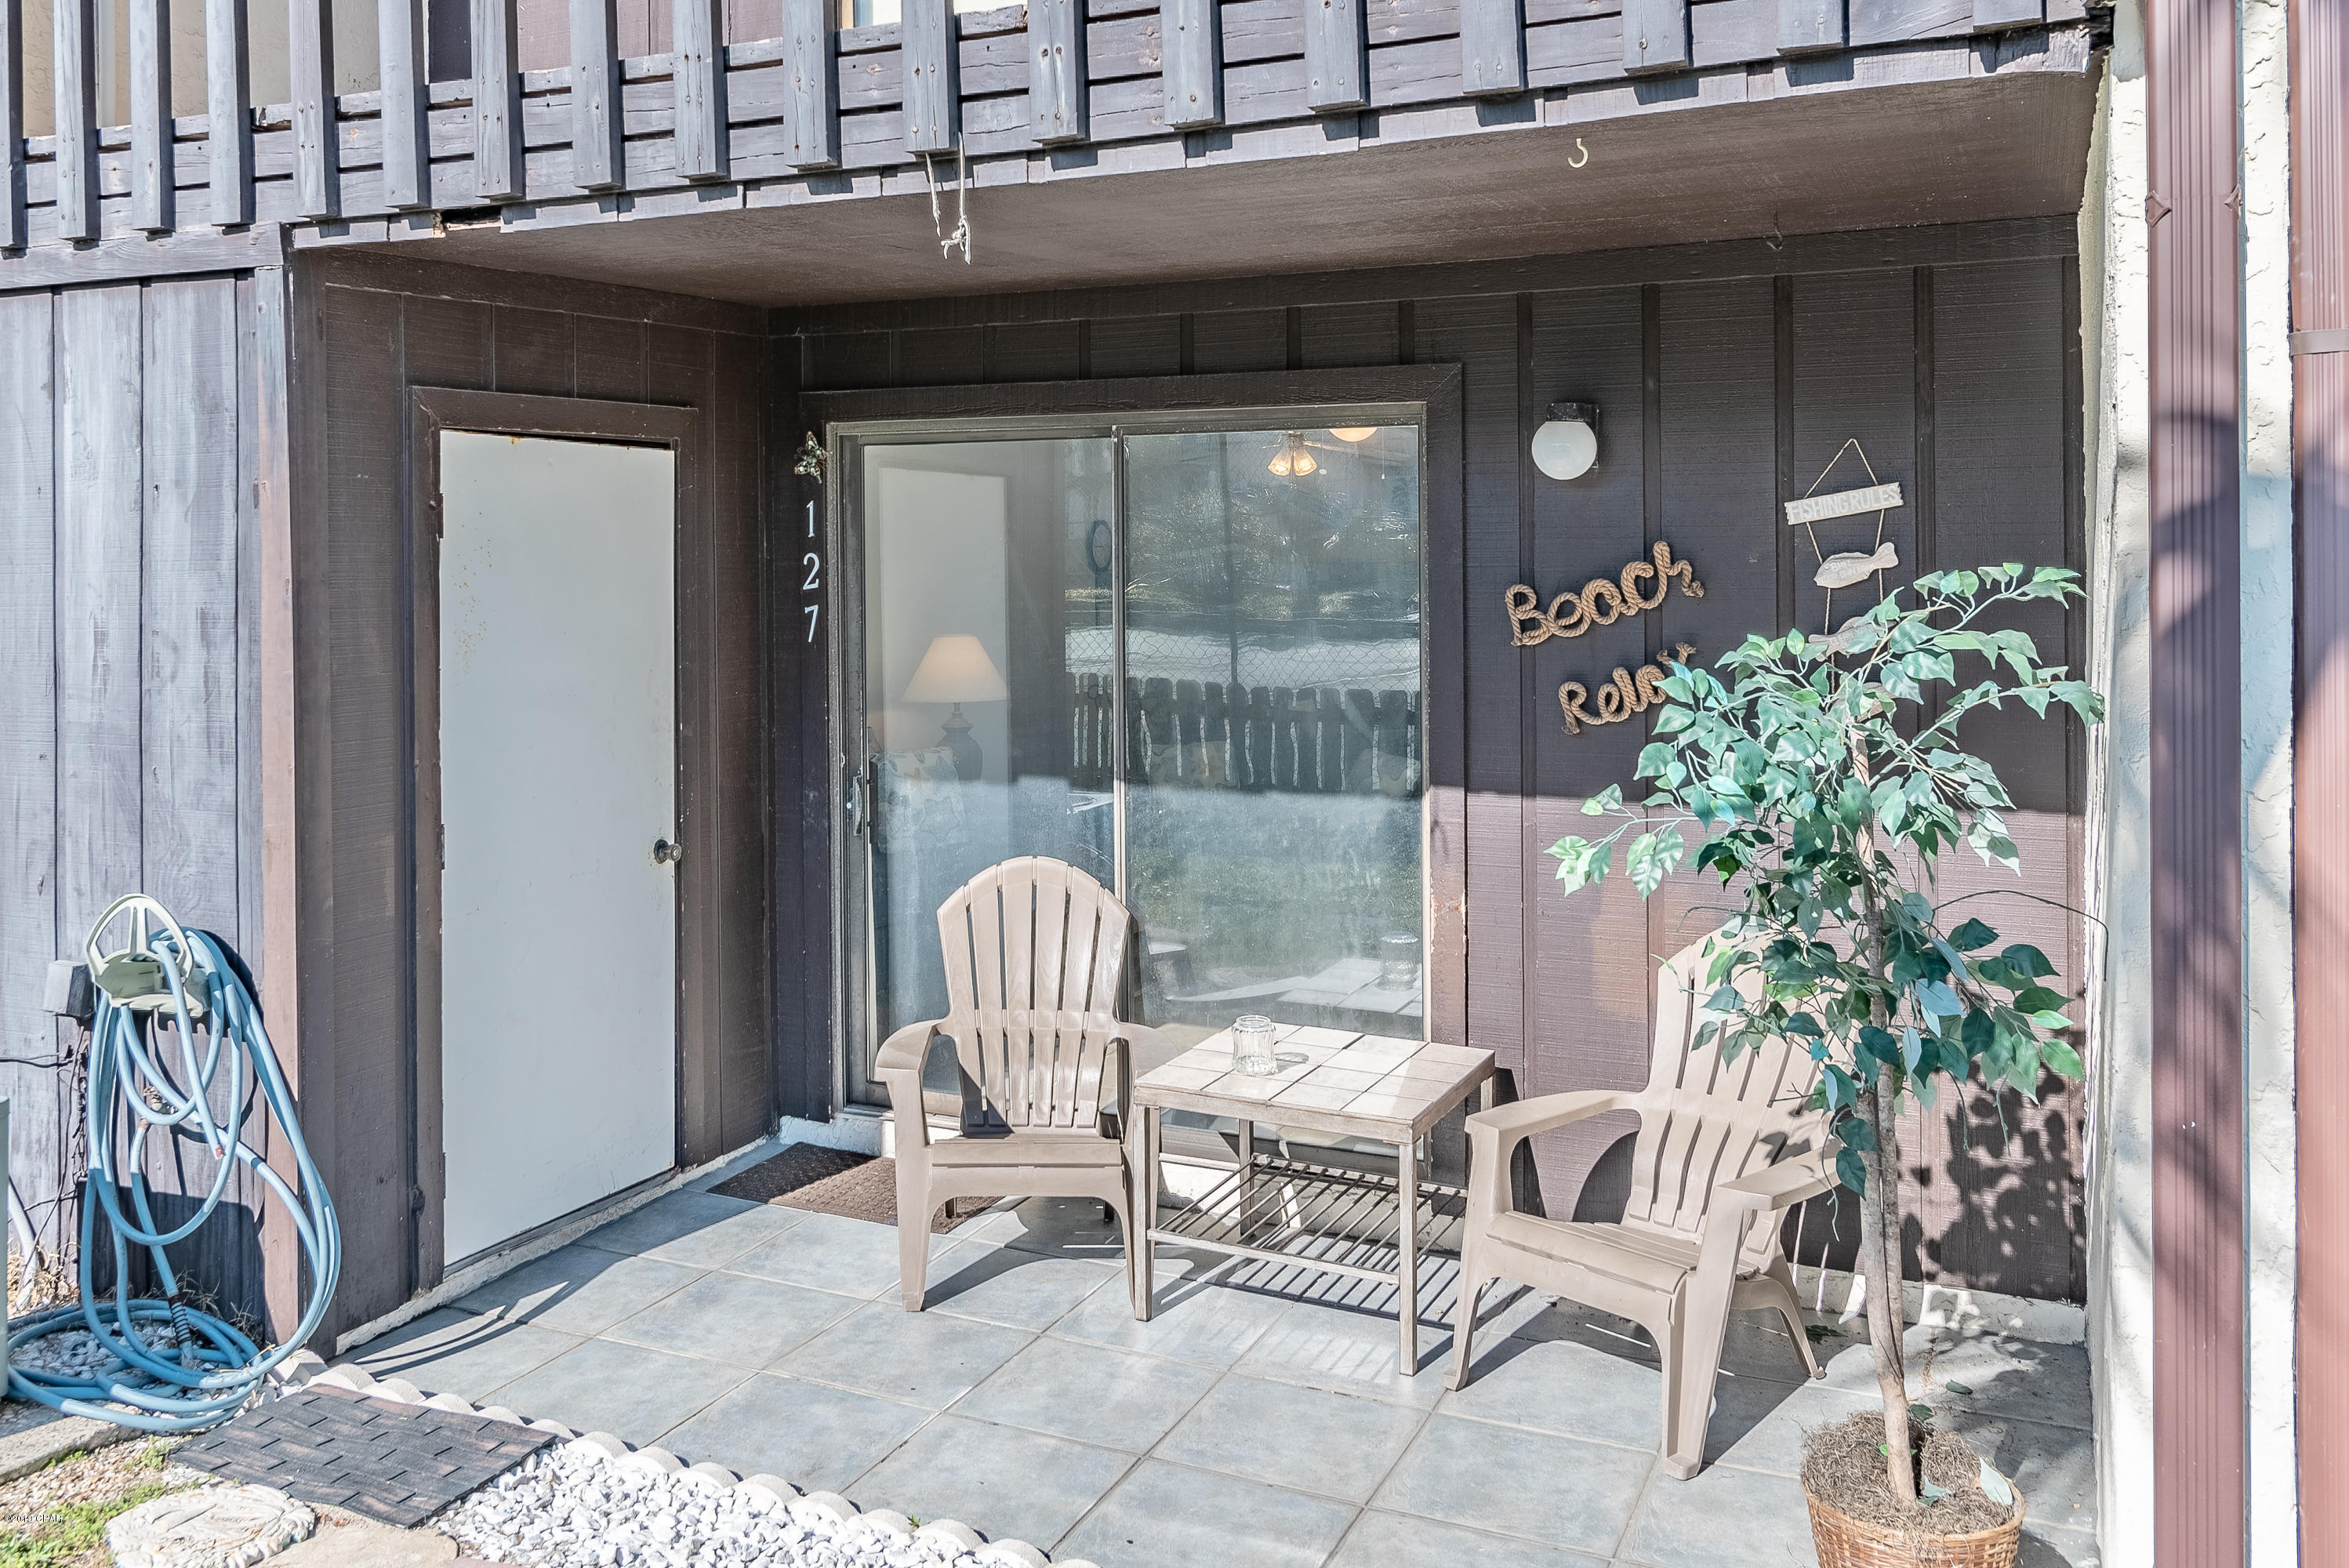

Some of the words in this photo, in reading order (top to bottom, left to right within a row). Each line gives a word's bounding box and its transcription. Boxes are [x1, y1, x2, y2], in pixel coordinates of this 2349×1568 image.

[1788, 495, 1849, 522] FISHING
[1850, 484, 1899, 510] RULES
[802, 500, 820, 643] 127
[1505, 541, 1705, 646] Beach
